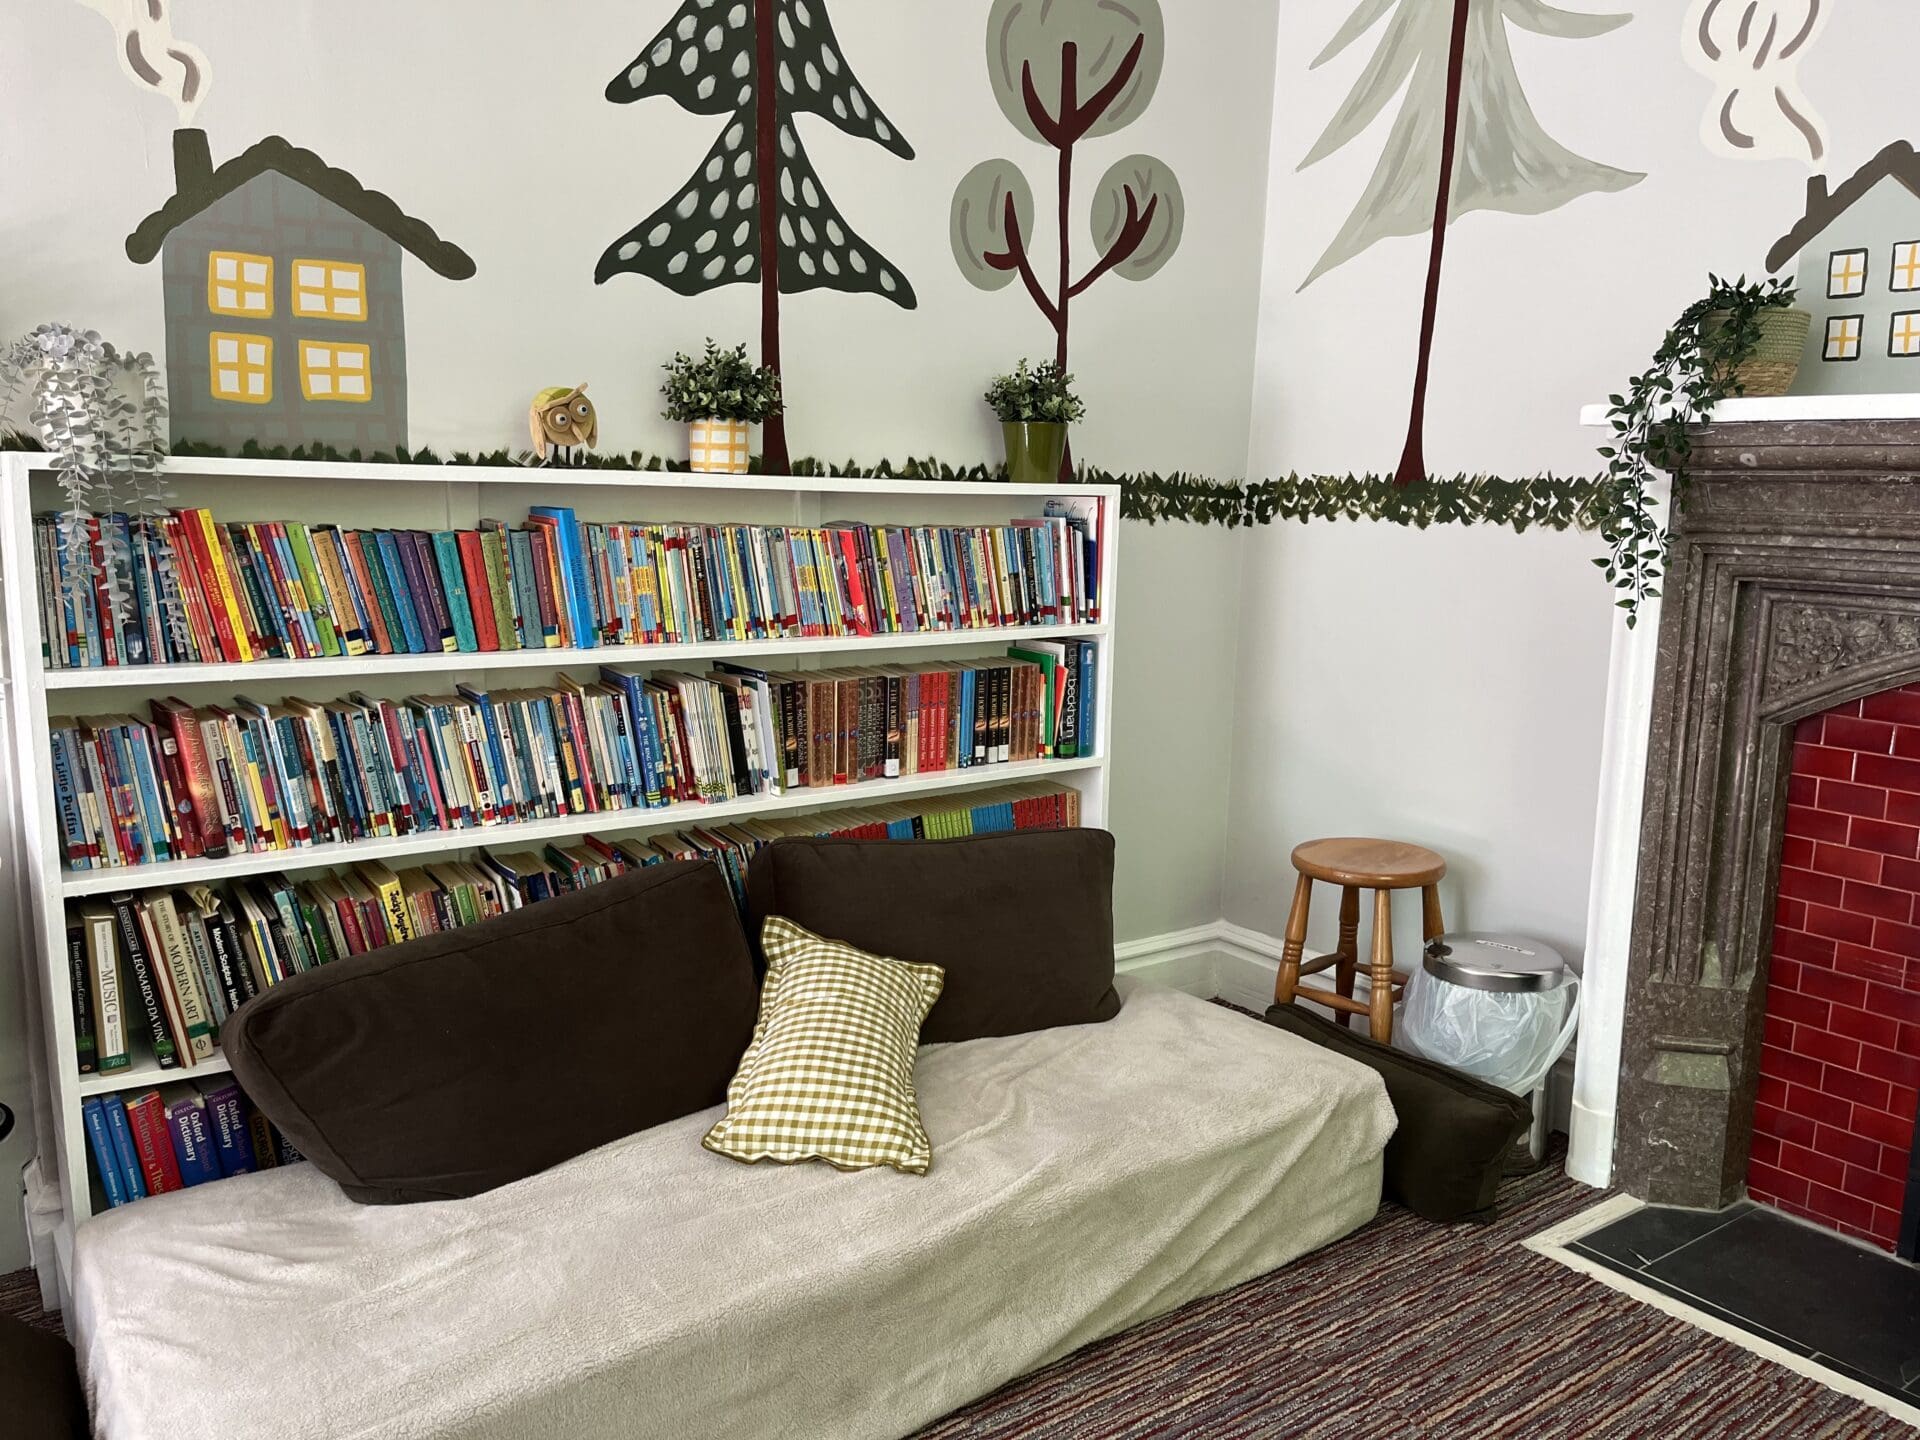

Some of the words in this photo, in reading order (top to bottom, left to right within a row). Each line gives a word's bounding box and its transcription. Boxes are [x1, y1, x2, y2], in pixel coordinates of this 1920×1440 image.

[635, 690, 645, 714] McGough
[1066, 678, 1076, 738] beckham
[642, 735, 650, 746] THE
[644, 747, 652, 760] RING
[54, 762, 72, 793] Little
[648, 771, 657, 791] WORDS
[61, 795, 80, 835] Puffin
[158, 900, 168, 913] THE
[388, 890, 403, 914] Jacky
[161, 913, 174, 934] STORY
[167, 932, 177, 943] OF
[193, 930, 202, 942] ART
[212, 927, 226, 955] Modern
[167, 944, 194, 997] MODERN
[197, 945, 212, 976] NOUVEAU
[218, 953, 235, 987] Sculpture
[100, 968, 118, 1013] MUSIC
[131, 952, 157, 1007] LEONARDO
[146, 1005, 161, 1022] DA
[182, 997, 200, 1022] ART
[188, 1111, 206, 1143] Oxford
[213, 1103, 237, 1149] Dictionary
[226, 1099, 243, 1130] Oxford
[132, 1106, 160, 1162] Dictionary
[176, 1115, 200, 1162] Dictionary
[90, 1113, 101, 1131] Oxford
[106, 1171, 120, 1198] Dictionary
[111, 1109, 122, 1127] Oxford
[127, 1167, 141, 1193] Dictionary
